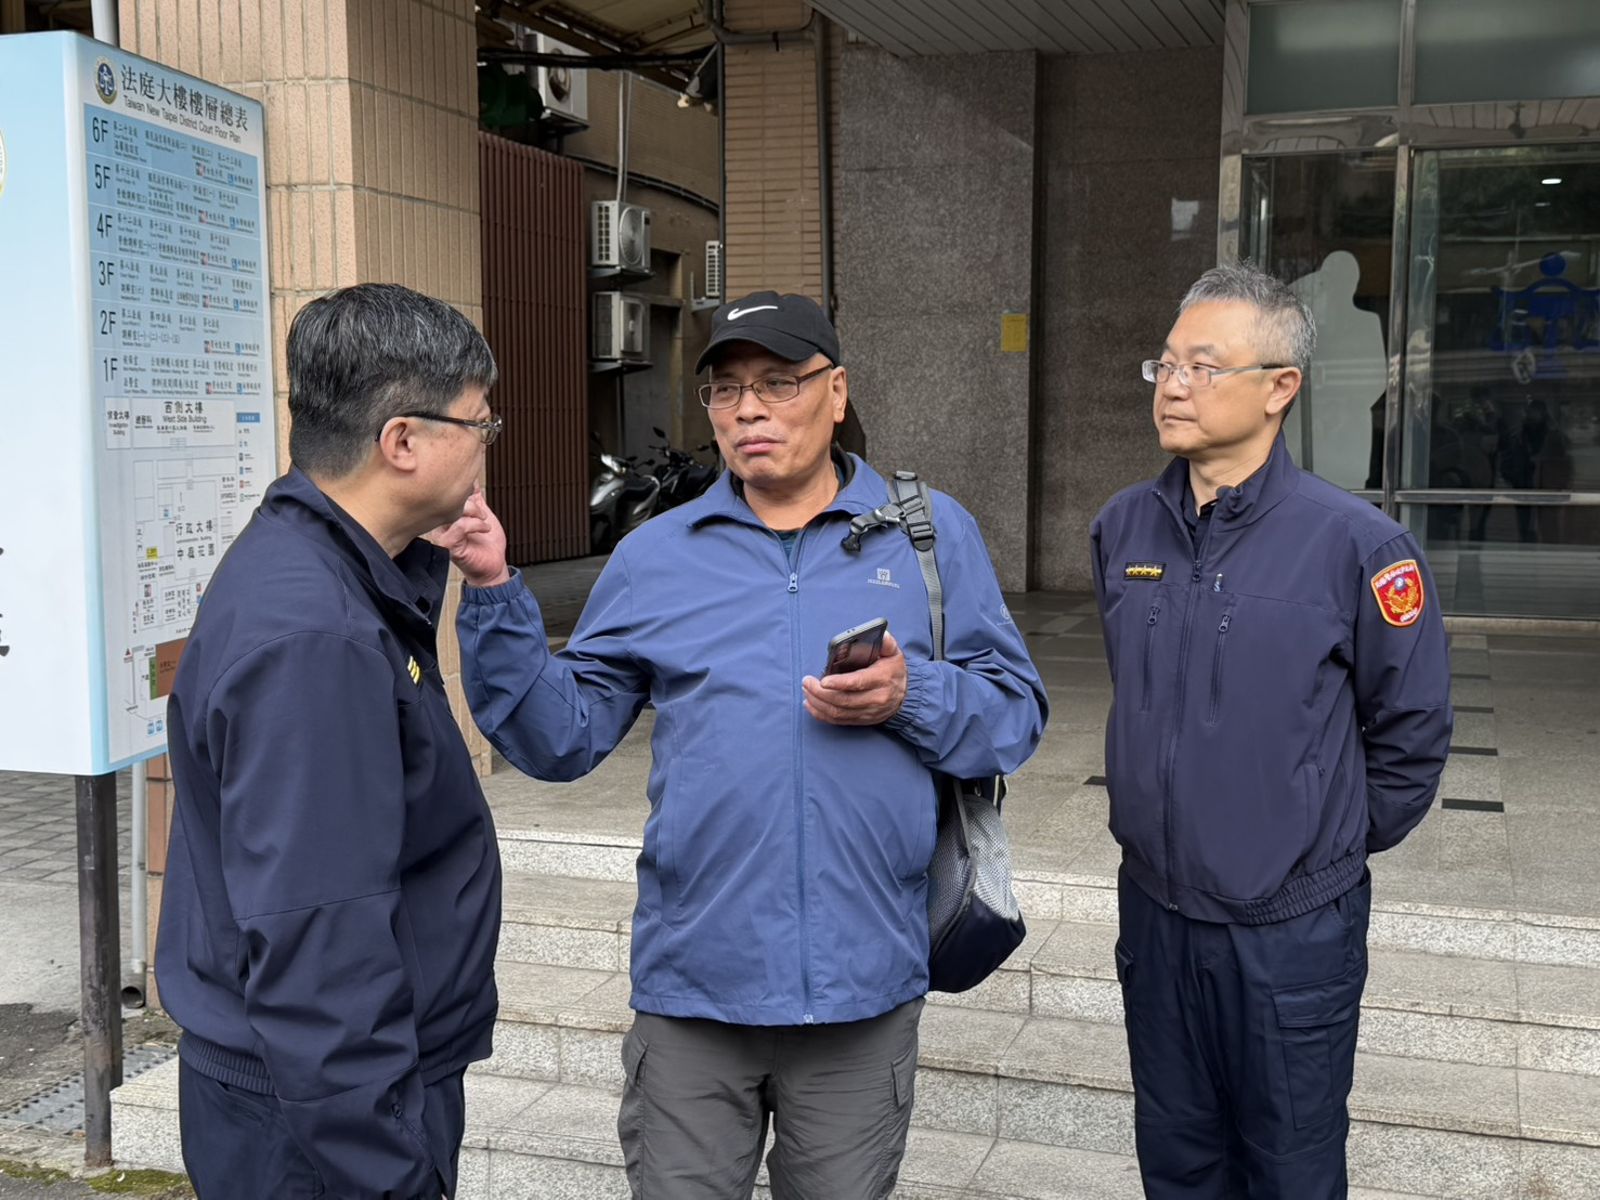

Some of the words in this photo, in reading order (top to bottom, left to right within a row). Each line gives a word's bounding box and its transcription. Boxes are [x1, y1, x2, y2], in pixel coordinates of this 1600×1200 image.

[121, 63, 248, 131] 法庭大樓樓層總表
[93, 116, 108, 143] 6F
[124, 95, 145, 113] Taiwan
[147, 102, 160, 118] New
[162, 106, 178, 126] Taipei
[180, 113, 198, 130] District
[199, 120, 213, 136] Court
[215, 126, 228, 140] Floor
[229, 131, 241, 144] Plan
[95, 163, 111, 189] 5F
[97, 213, 112, 238] 4F
[99, 260, 114, 286] 3F
[100, 310, 116, 335] 2F
[103, 356, 118, 382] 1F
